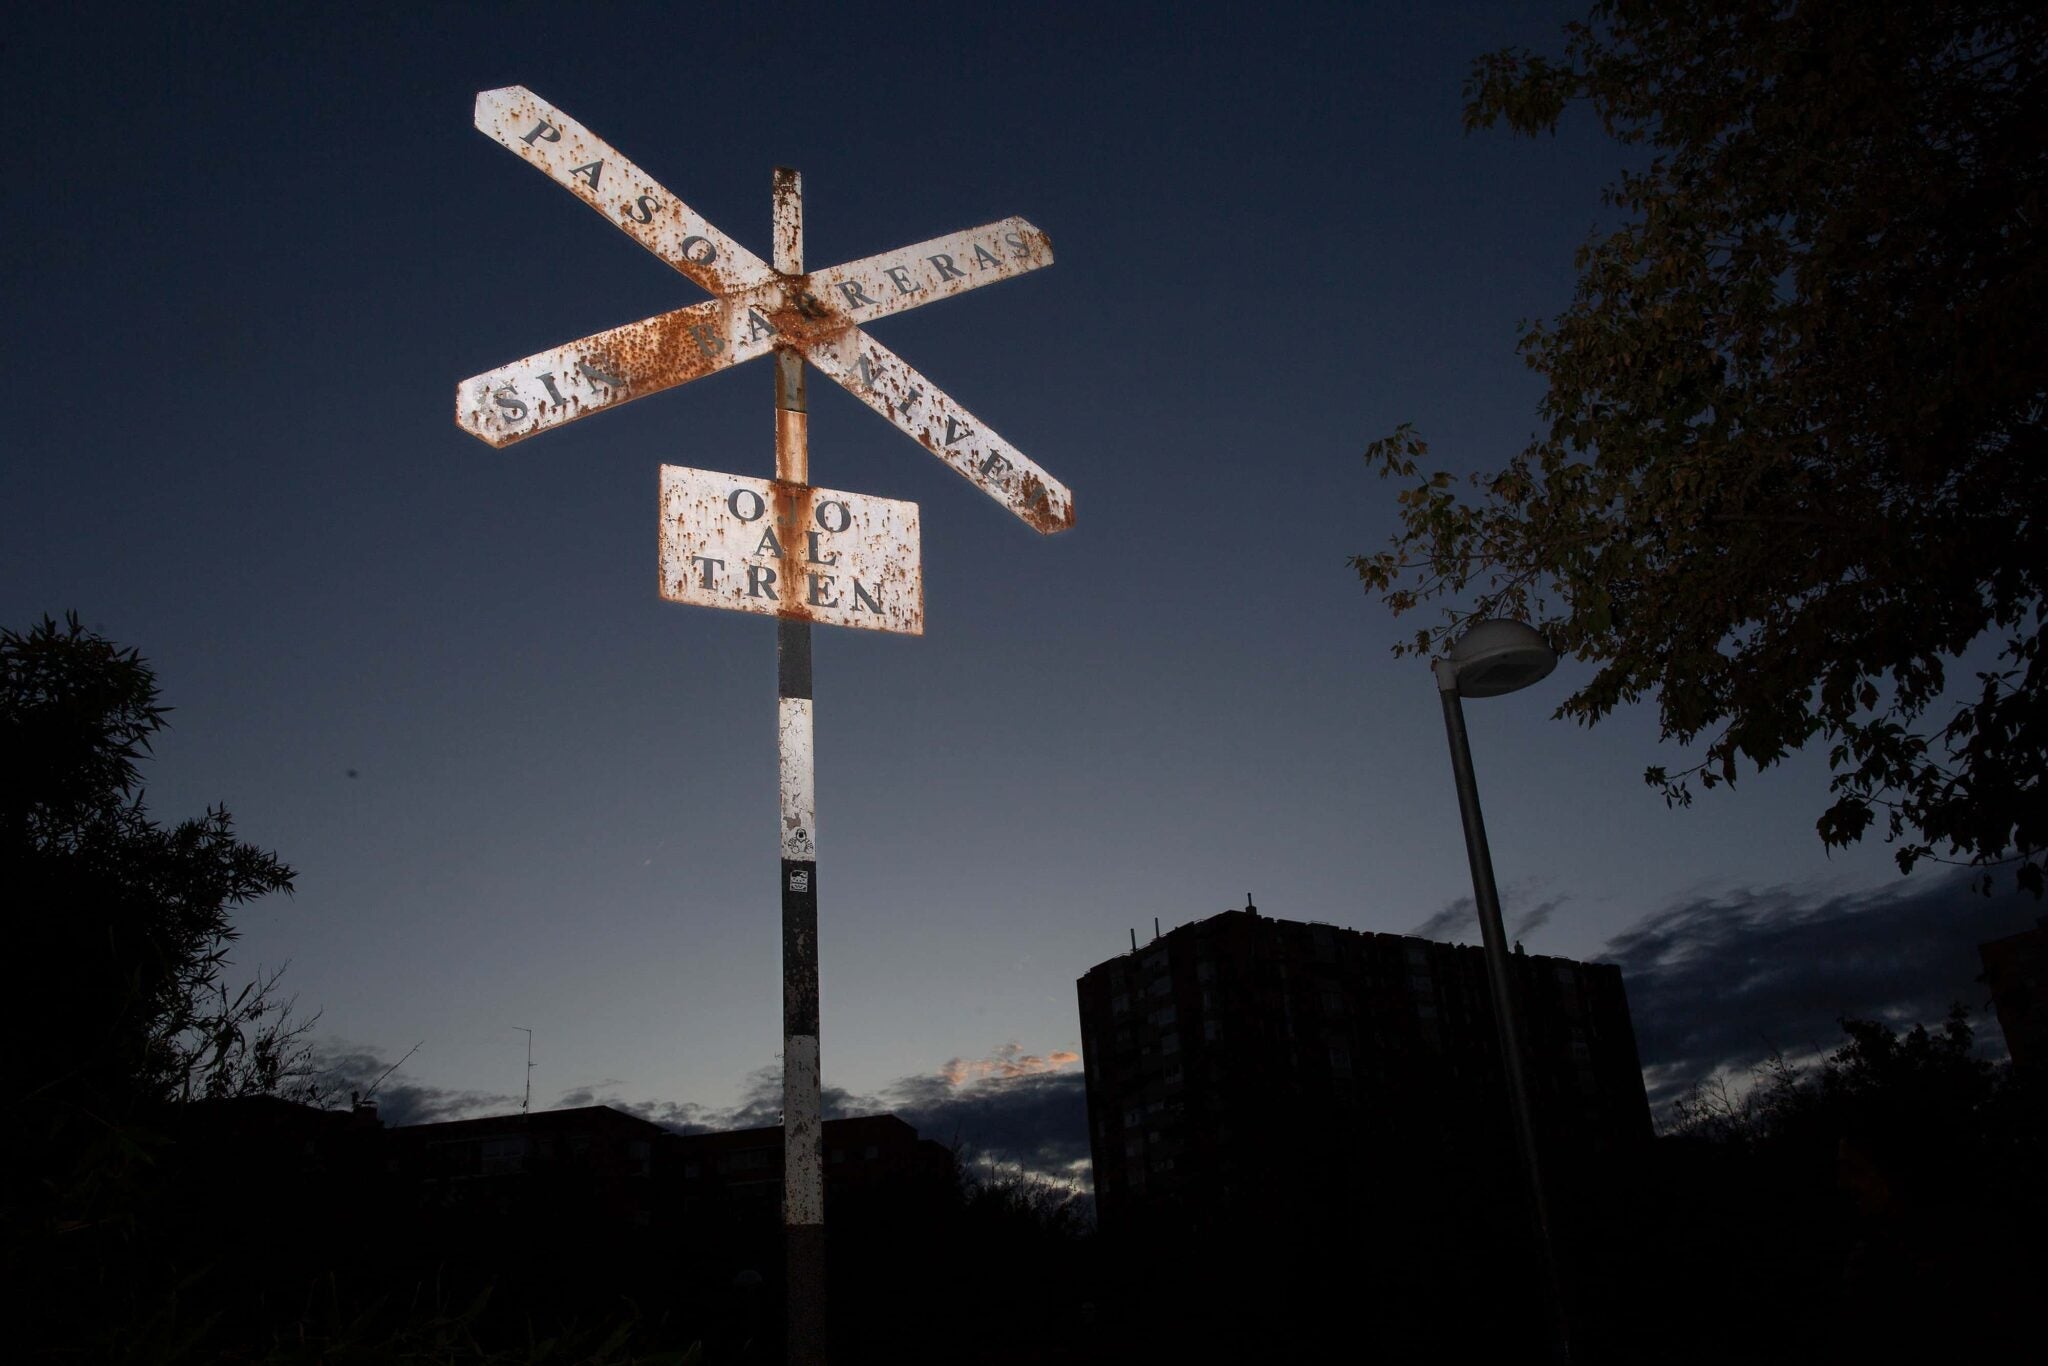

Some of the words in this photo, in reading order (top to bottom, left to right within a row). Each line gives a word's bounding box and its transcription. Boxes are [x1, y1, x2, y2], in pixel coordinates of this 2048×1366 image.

[518, 118, 717, 266] PASO
[493, 351, 626, 424] SIN
[688, 231, 1033, 356] BARRERAS
[727, 488, 852, 533] OJO
[753, 524, 836, 566] AL
[691, 555, 885, 615] TREN
